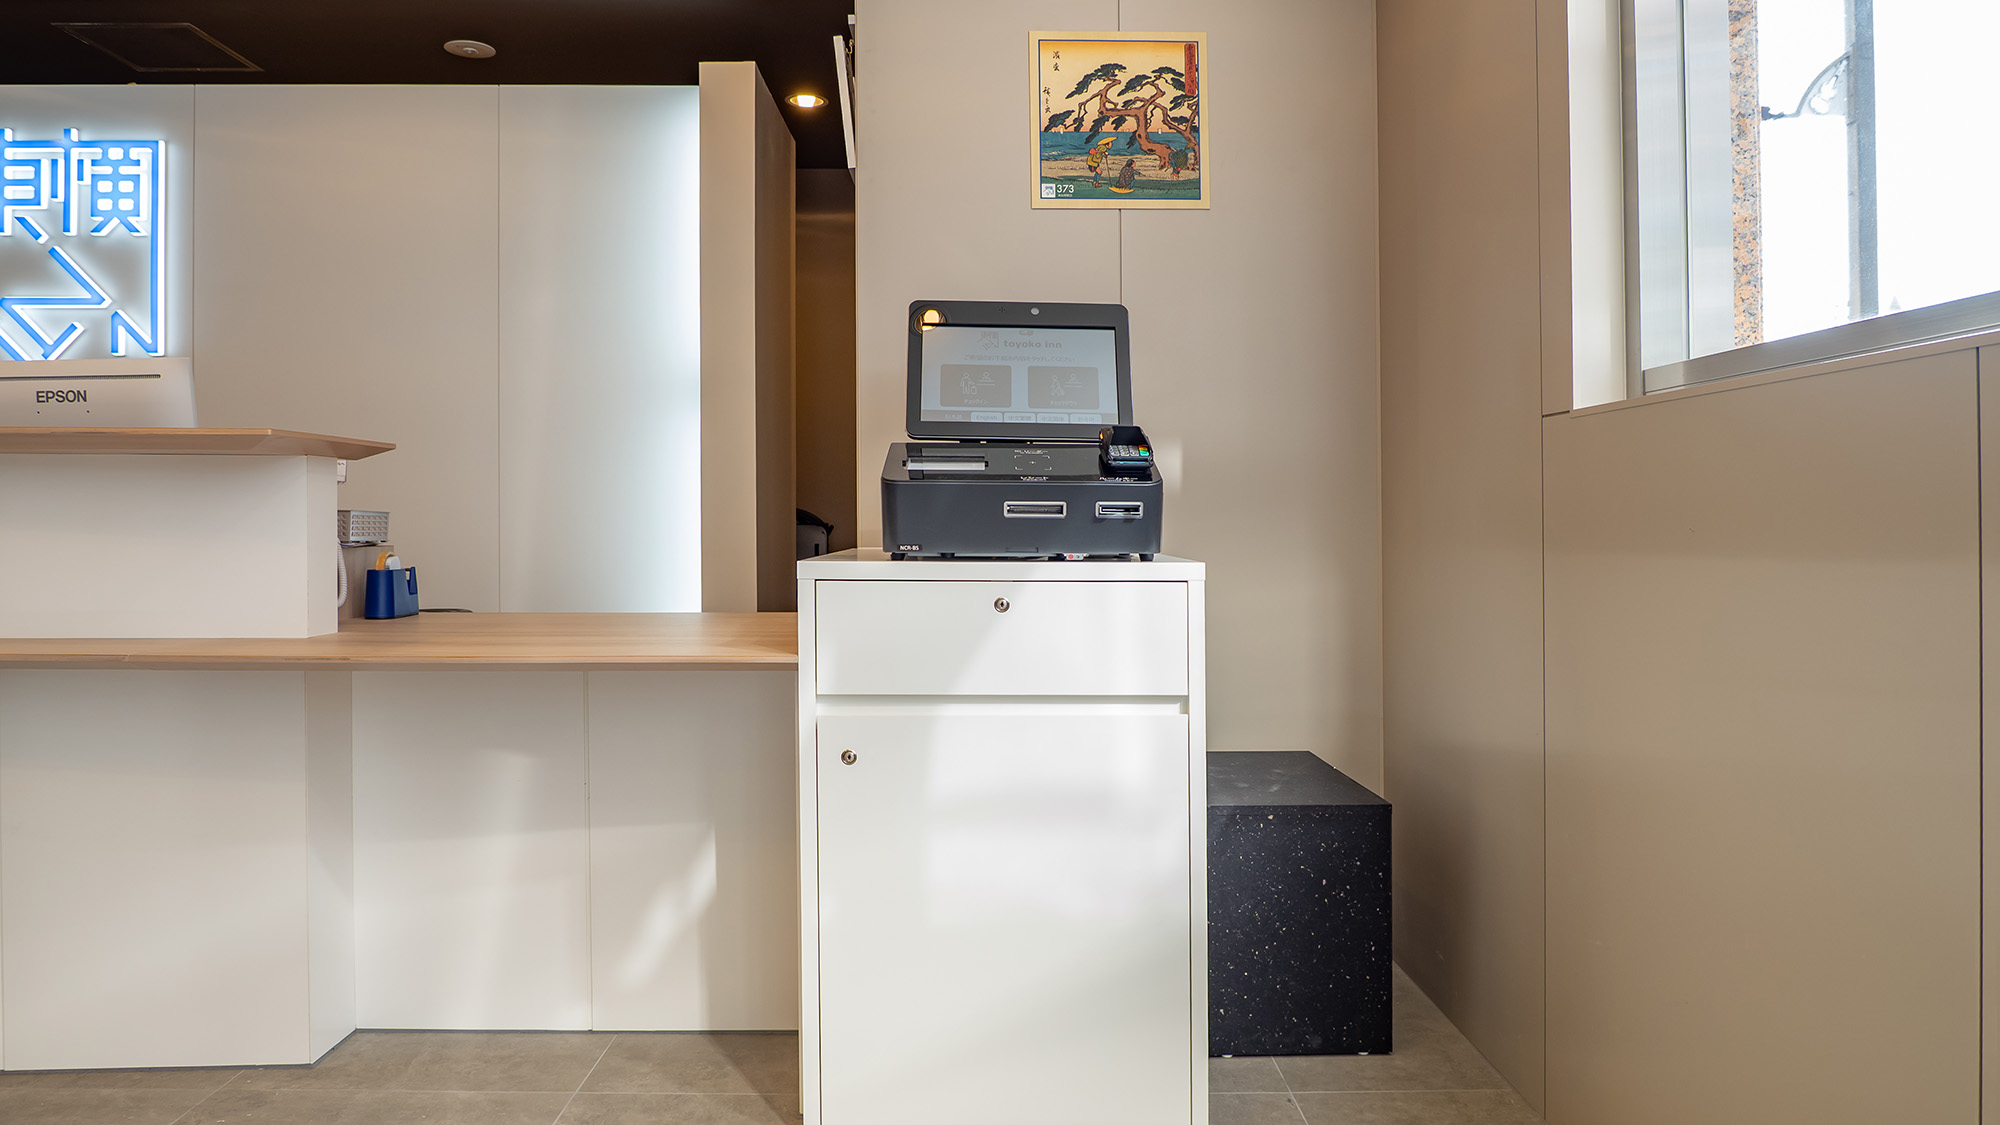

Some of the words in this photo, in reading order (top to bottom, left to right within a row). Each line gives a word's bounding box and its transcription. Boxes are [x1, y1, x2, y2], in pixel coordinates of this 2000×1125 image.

[1056, 184, 1074, 193] 373
[1004, 340, 1041, 350] toyoko
[1045, 341, 1062, 349] inn
[36, 390, 87, 403] EPSON
